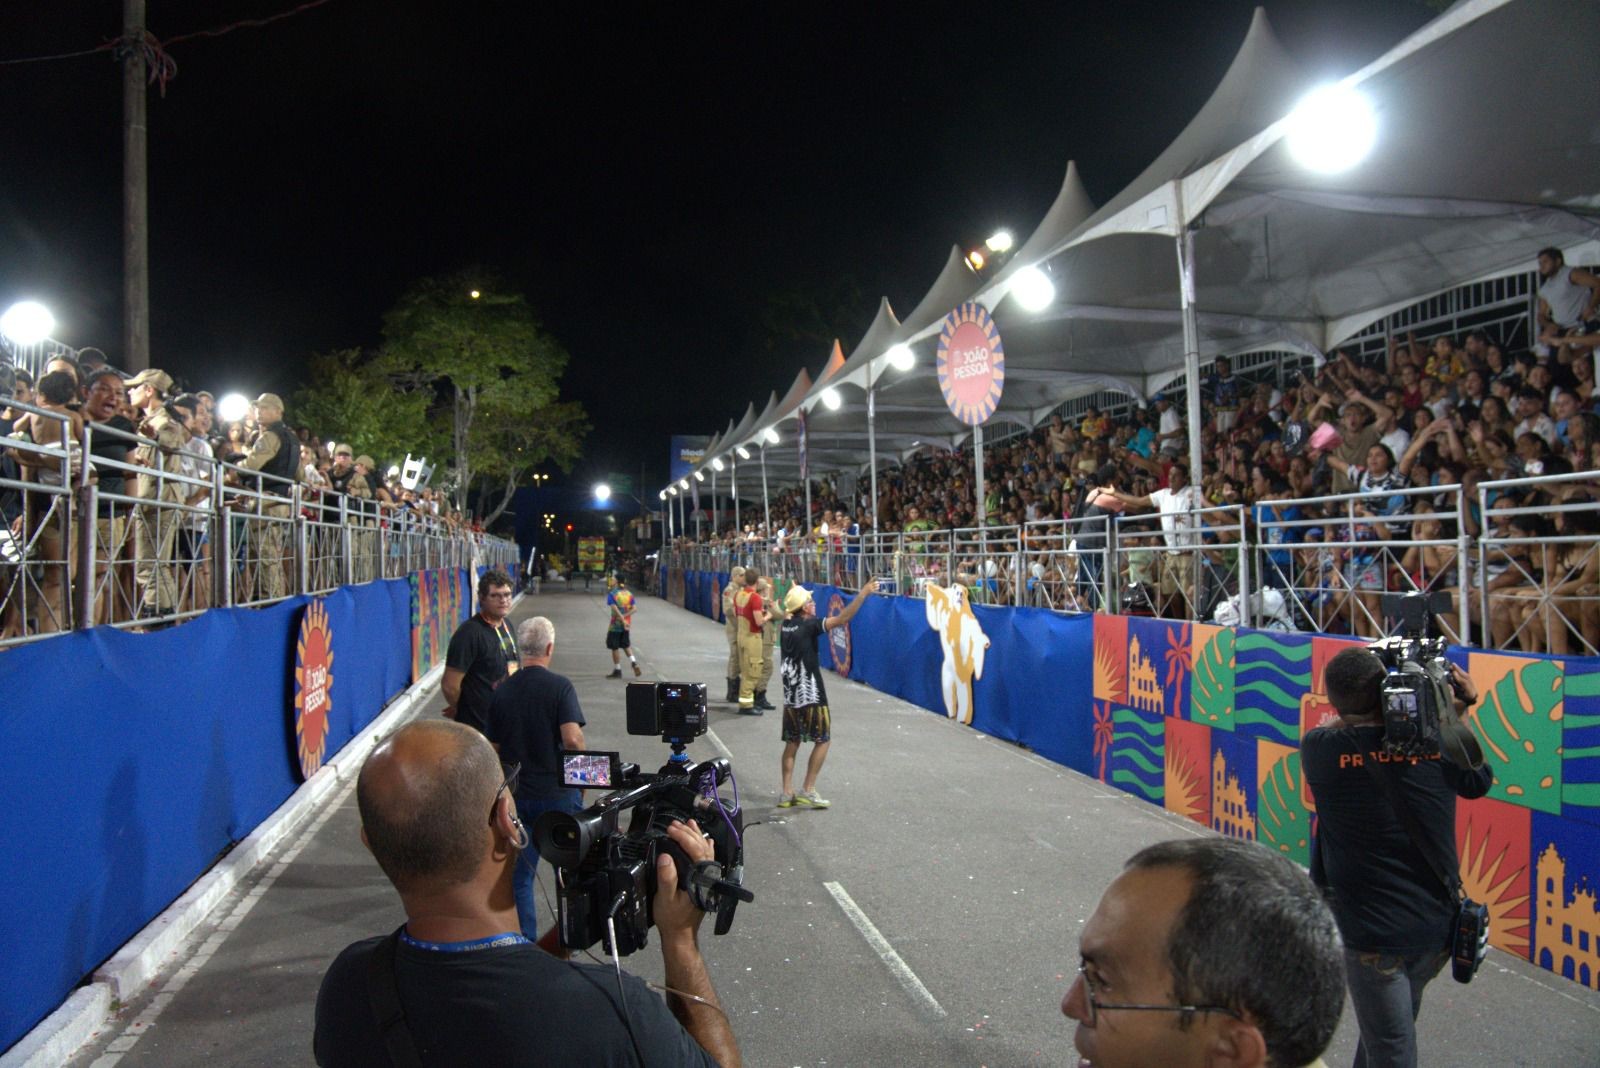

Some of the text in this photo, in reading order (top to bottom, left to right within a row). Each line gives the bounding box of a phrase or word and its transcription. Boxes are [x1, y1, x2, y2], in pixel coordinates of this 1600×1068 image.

[963, 346, 989, 365] JOÃO
[953, 360, 990, 380] PESSOA
[311, 664, 327, 690] JOÃO
[304, 686, 326, 715] PESSOA
